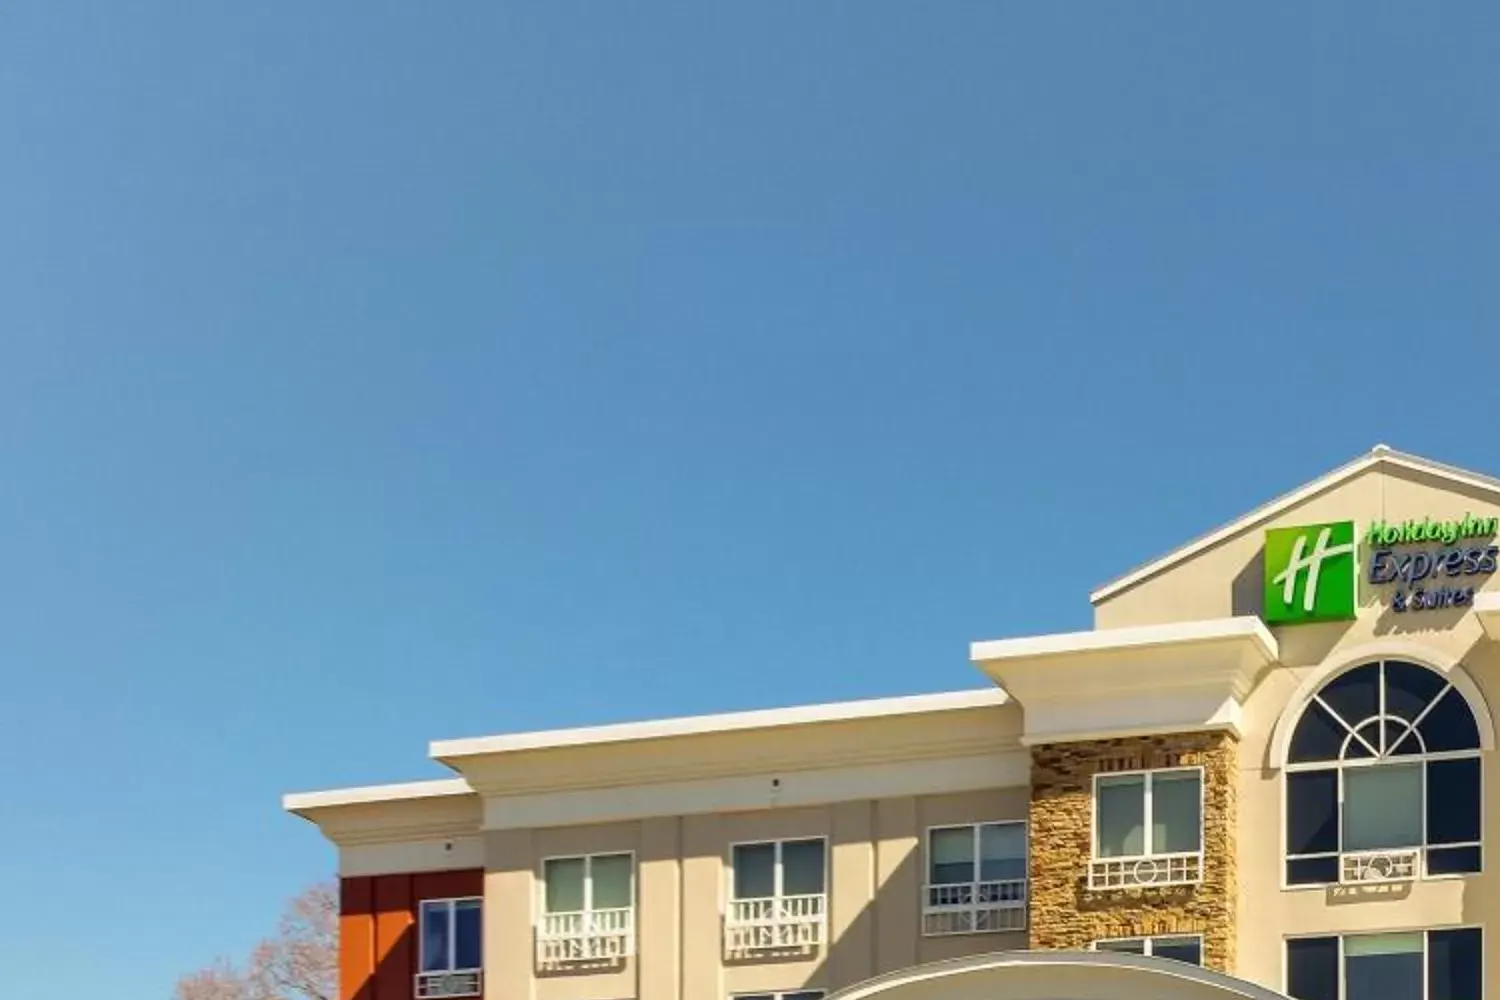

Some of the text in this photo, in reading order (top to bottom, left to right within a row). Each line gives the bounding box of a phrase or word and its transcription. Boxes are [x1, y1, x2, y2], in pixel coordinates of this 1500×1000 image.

[1366, 512, 1499, 546] Holiday Inn
[1368, 545, 1499, 587] Express
[1392, 587, 1475, 612] & Suites
